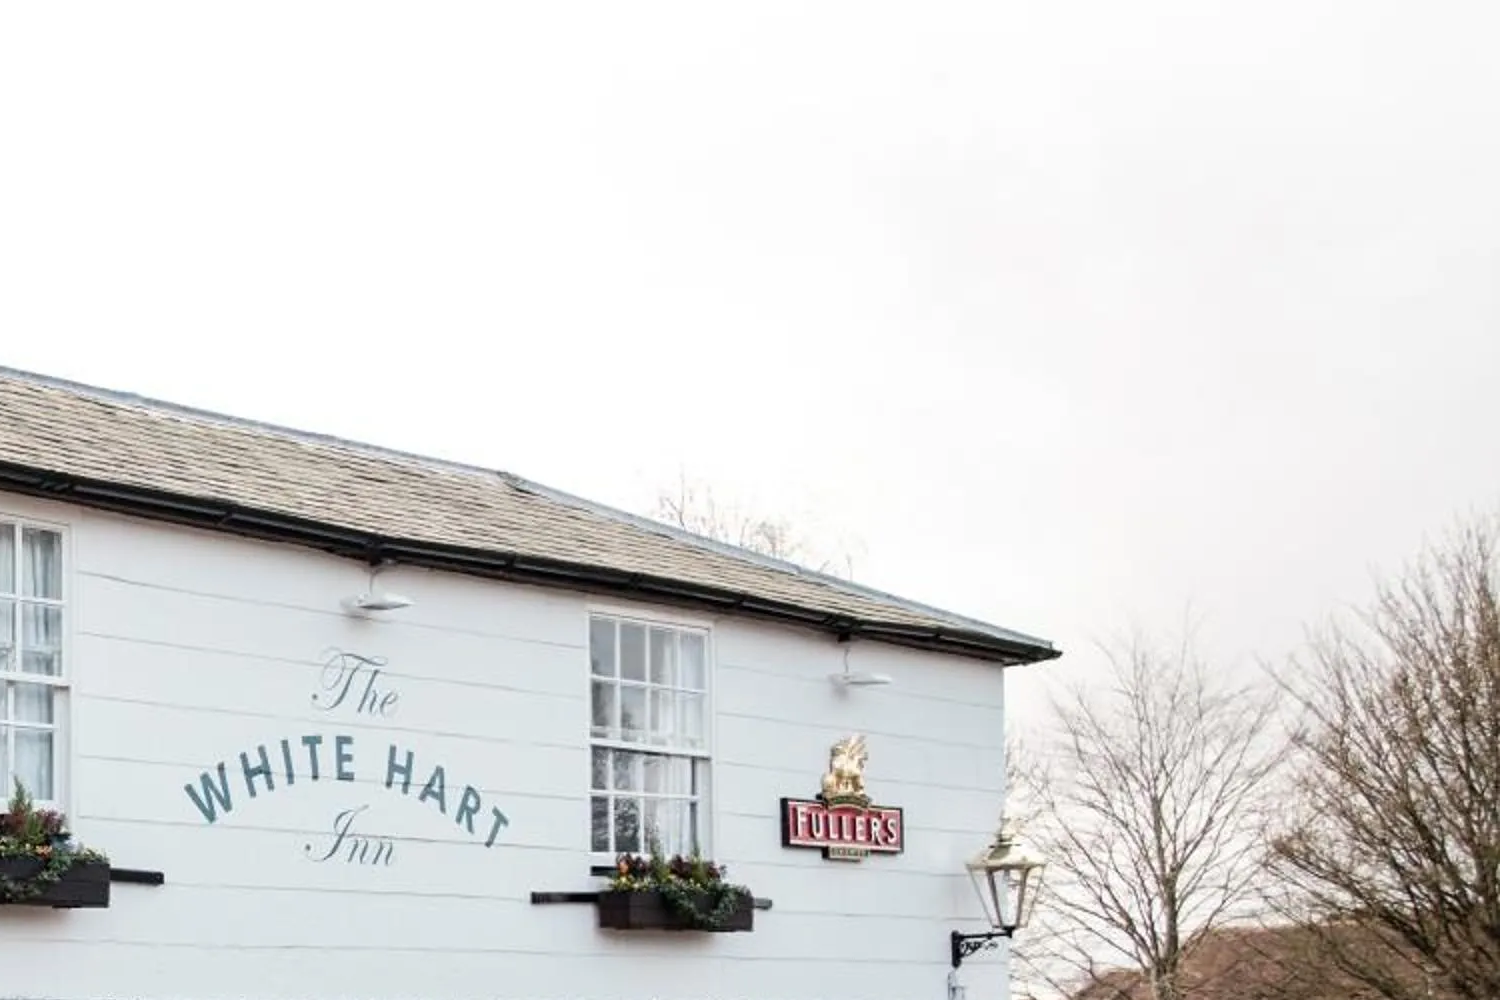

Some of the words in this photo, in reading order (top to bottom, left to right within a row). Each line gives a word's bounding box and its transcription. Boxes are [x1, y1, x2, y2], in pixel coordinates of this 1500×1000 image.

[311, 646, 400, 714] The
[183, 734, 355, 825] WHITE
[384, 743, 509, 848] HART
[304, 803, 394, 866] Inn
[795, 806, 898, 846] FULLER'S
